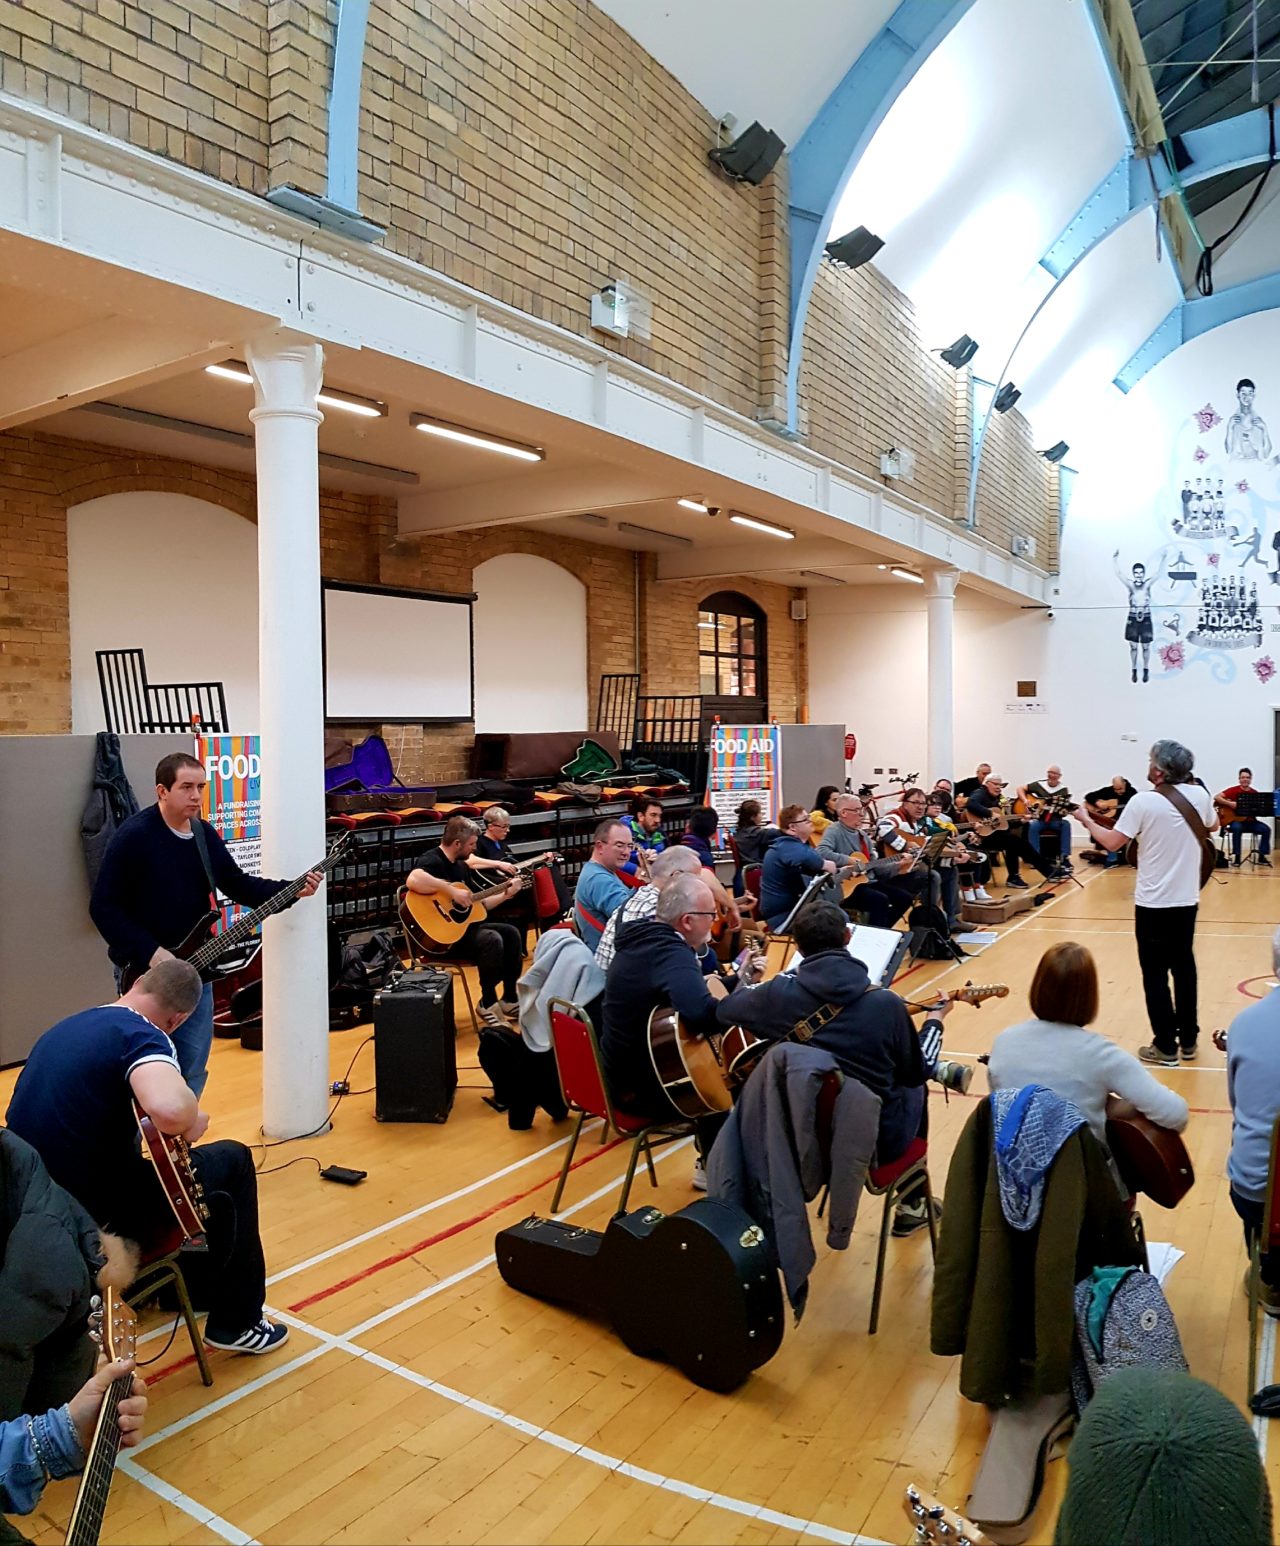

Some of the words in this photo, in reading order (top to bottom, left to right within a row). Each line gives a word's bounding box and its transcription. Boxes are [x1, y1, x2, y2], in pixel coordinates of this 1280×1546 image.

[710, 738, 747, 753] FOOD
[749, 738, 774, 753] AID
[205, 754, 261, 781] FOOD
[207, 810, 248, 820] SUPPORTING
[215, 821, 238, 830] SPACES
